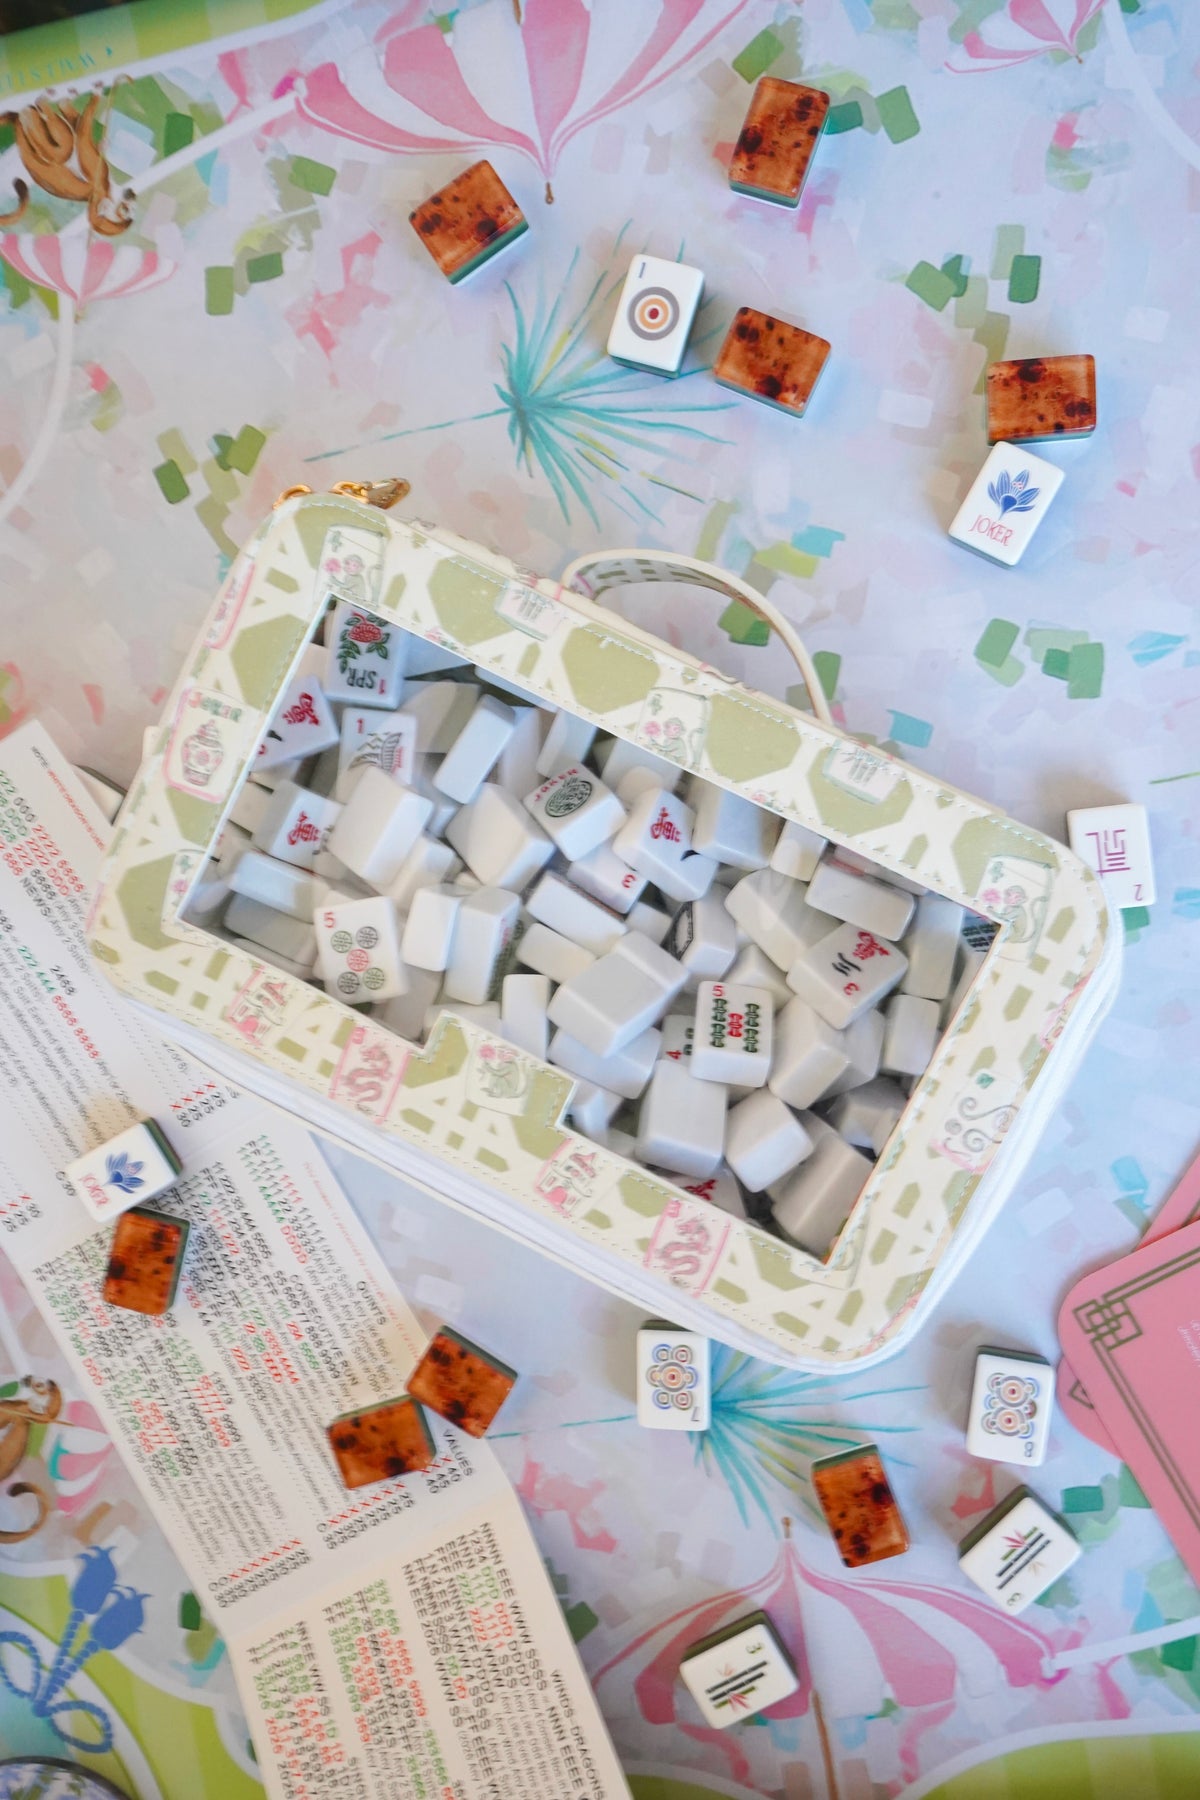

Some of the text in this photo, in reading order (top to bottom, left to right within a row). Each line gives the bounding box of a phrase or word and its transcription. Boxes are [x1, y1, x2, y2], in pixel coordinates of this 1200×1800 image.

[638, 262, 647, 279] 1
[968, 514, 1014, 547] JOKER
[345, 668, 379, 690] SPR
[356, 718, 365, 734] 1
[535, 768, 580, 802] JOKER
[45, 866, 71, 898] DDD
[18, 875, 52, 918] NEWS
[323, 911, 337, 929] 5
[712, 985, 726, 997] 5
[198, 1096, 215, 1115] 25
[210, 1090, 226, 1108] 25
[175, 1110, 192, 1129] 30
[187, 1103, 203, 1122] 25
[244, 1138, 262, 1159] FF
[60, 1179, 77, 1199] 30
[78, 1173, 111, 1208] JOKER
[279, 1222, 311, 1266] DDDD
[258, 1273, 279, 1299] FFF
[271, 1268, 289, 1288] 55
[354, 1278, 388, 1327] QUINTS
[288, 1271, 344, 1360] CONSECUTIVE
[336, 1358, 359, 1388] RUN
[81, 1356, 105, 1388] DDD
[440, 1428, 475, 1478] VALUES
[1023, 1441, 1035, 1458] 8
[434, 1470, 450, 1489] 45
[445, 1464, 461, 1482] 40
[423, 1476, 439, 1495] 40
[398, 1490, 414, 1508] 25
[341, 1521, 358, 1539] 30
[352, 1515, 368, 1533] 25
[321, 1532, 338, 1551] 35
[294, 1547, 310, 1565] 25
[213, 1591, 229, 1610] 30
[467, 1527, 531, 1688] 1234 DDD DDD DDDD
[444, 1540, 504, 1689] EEE 2222 2222 WWW
[455, 1534, 476, 1570] NNN
[496, 1653, 517, 1689] SSS
[433, 1546, 496, 1704] FFF NNNN FFF DDDD
[399, 1563, 465, 1728] NN EEE 2026 WWW SS
[411, 1557, 425, 1575] FF
[431, 1616, 453, 1654] SSSS
[444, 1654, 461, 1677] DD
[464, 1714, 480, 1735] FF
[426, 1563, 492, 1730] N 2 EE 3 WWW 4 SSSS
[479, 1520, 583, 1790] NNNN EEE WWW SSSS NNN EEEE
[373, 1698, 399, 1748] NEWS
